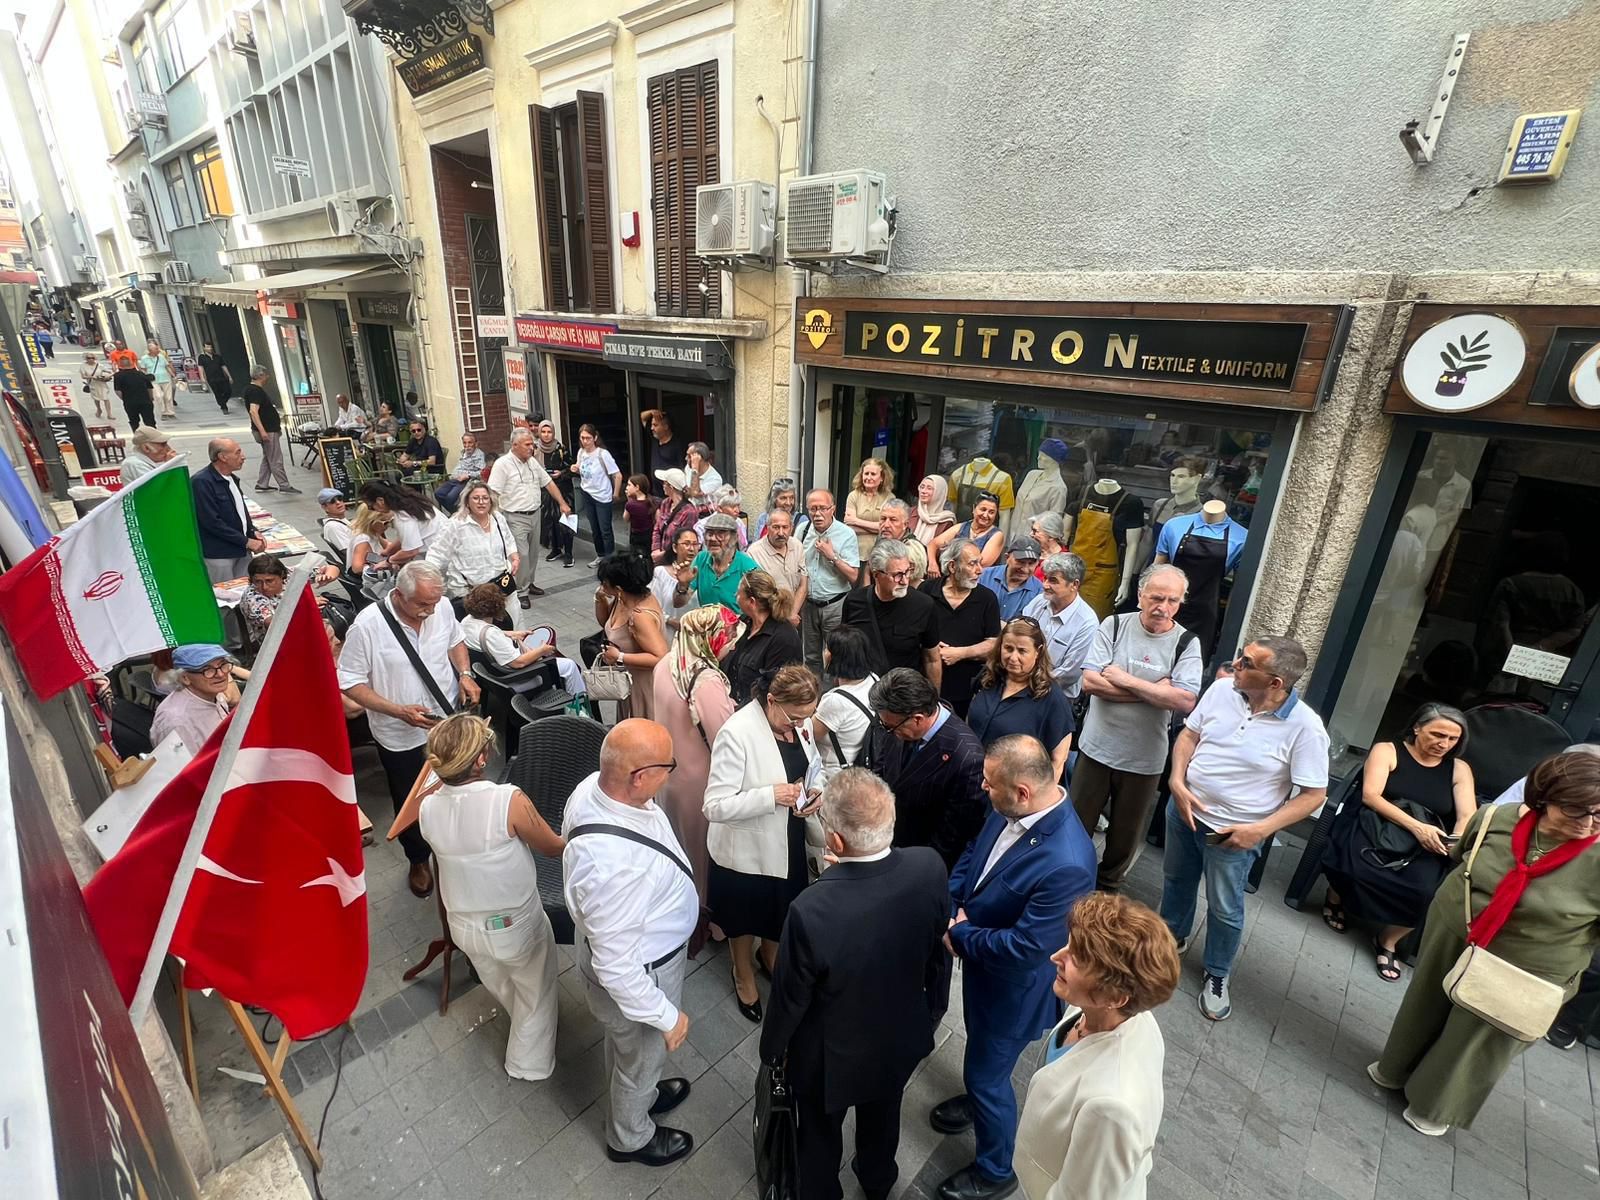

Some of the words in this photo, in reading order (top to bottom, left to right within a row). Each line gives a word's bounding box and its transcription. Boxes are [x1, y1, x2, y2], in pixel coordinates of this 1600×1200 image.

[446, 39, 473, 62] HUKUK
[1523, 133, 1560, 141] ALARM
[1531, 152, 1542, 164] 76
[1542, 152, 1553, 163] 36
[567, 328, 577, 343] VE
[576, 325, 584, 347] İŞ
[584, 329, 600, 346] HANI
[800, 325, 836, 333] POZİTRON
[604, 343, 628, 356] ÇINAR
[646, 345, 676, 360] TEKEL
[861, 318, 1139, 368] POZİTRON
[1141, 355, 1195, 374] TEXTILE
[1200, 358, 1211, 374] &
[1215, 359, 1287, 380] UNIFORM
[506, 357, 525, 375] TERZİ
